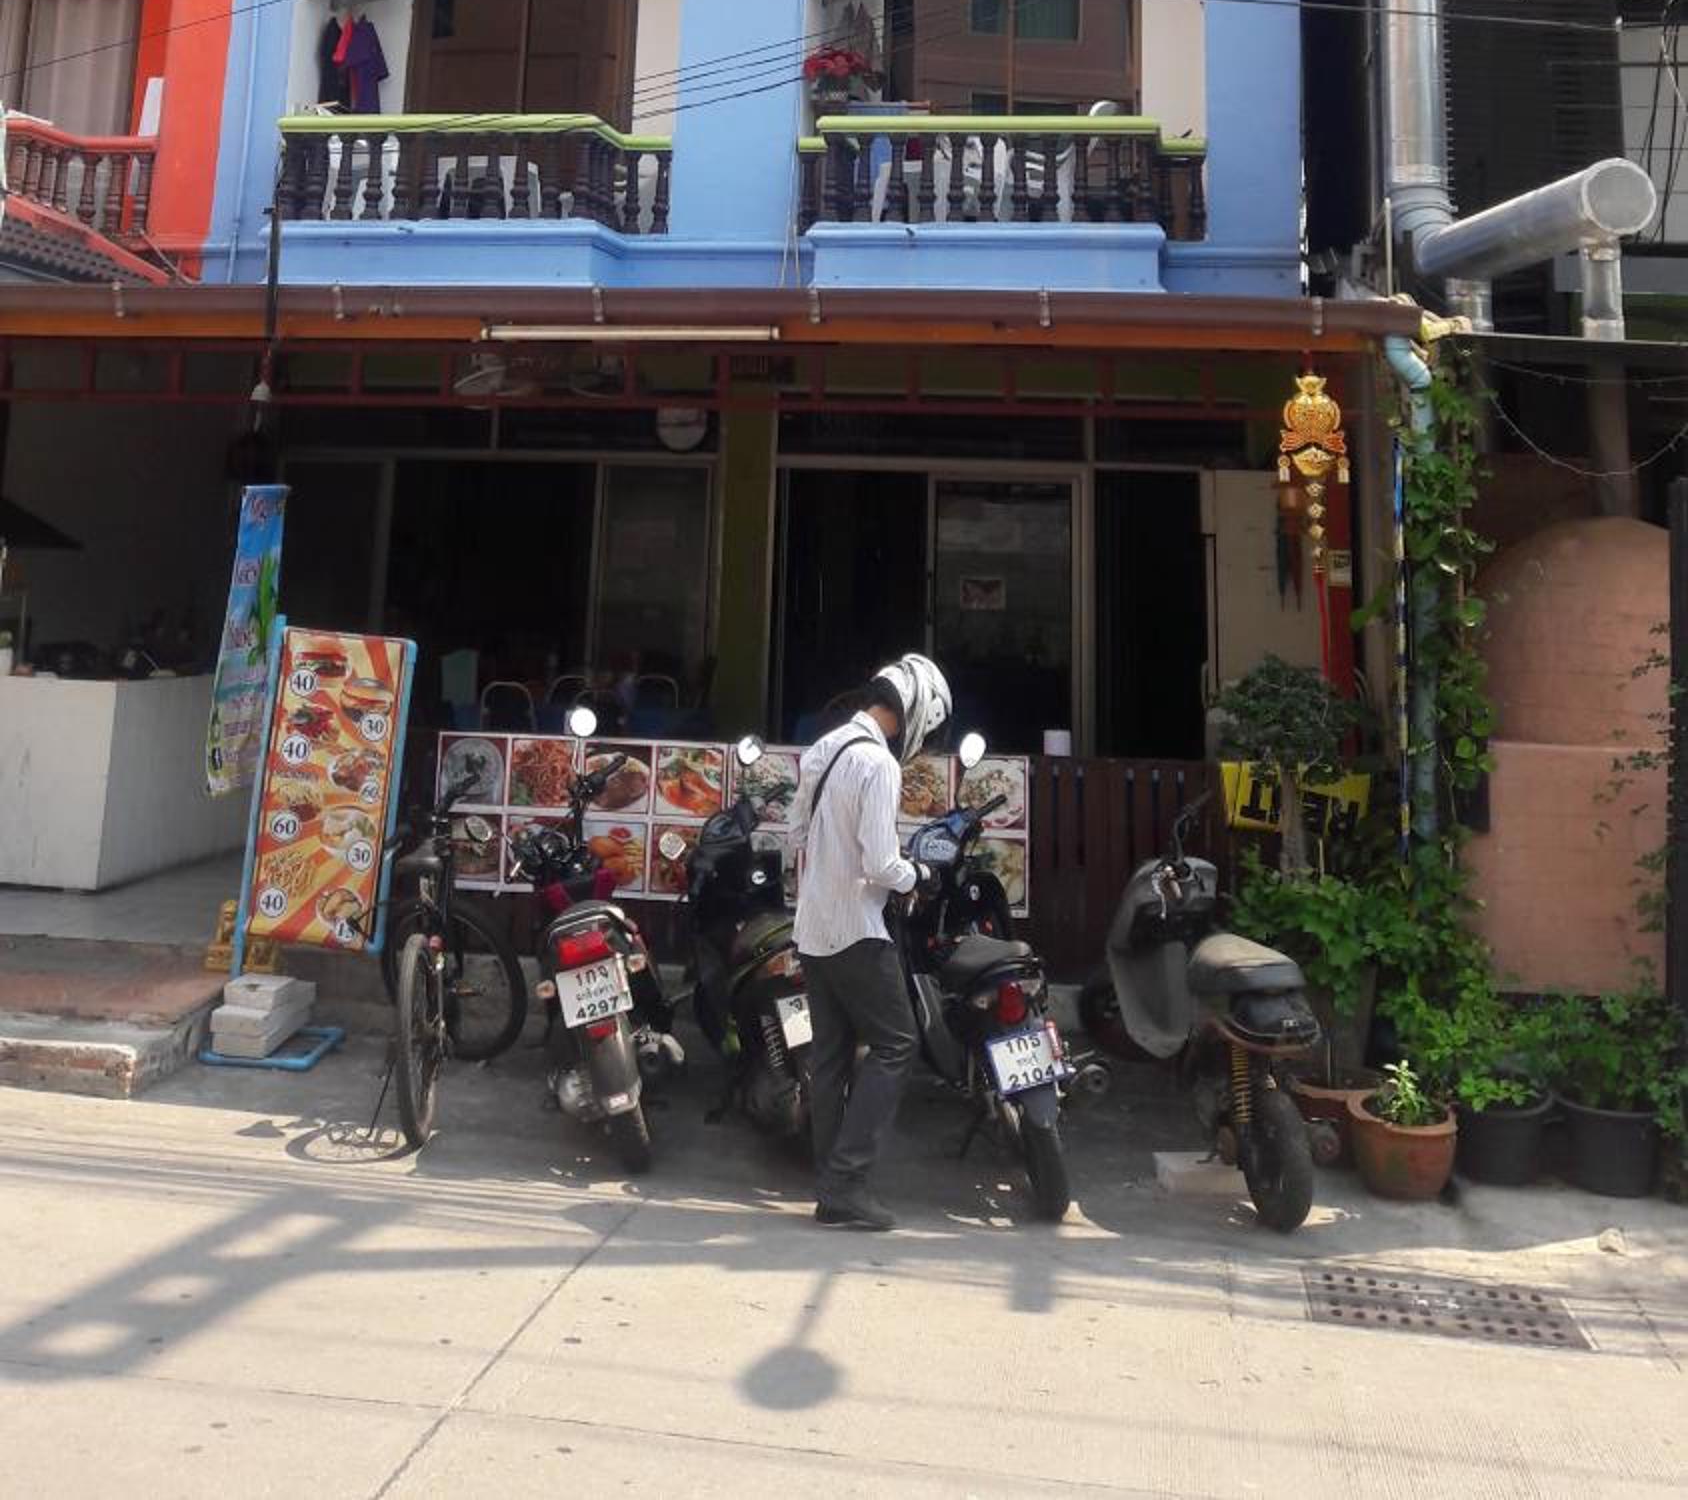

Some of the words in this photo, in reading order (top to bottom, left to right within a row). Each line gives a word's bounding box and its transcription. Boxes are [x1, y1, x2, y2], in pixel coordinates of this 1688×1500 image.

[293, 674, 315, 691] 40
[366, 718, 383, 735] 30
[283, 741, 308, 759] 40
[273, 819, 297, 836] 60
[351, 846, 371, 862] 30
[261, 895, 284, 911] 40
[575, 995, 619, 1019] 4297
[1008, 1063, 1056, 1088] 2104
